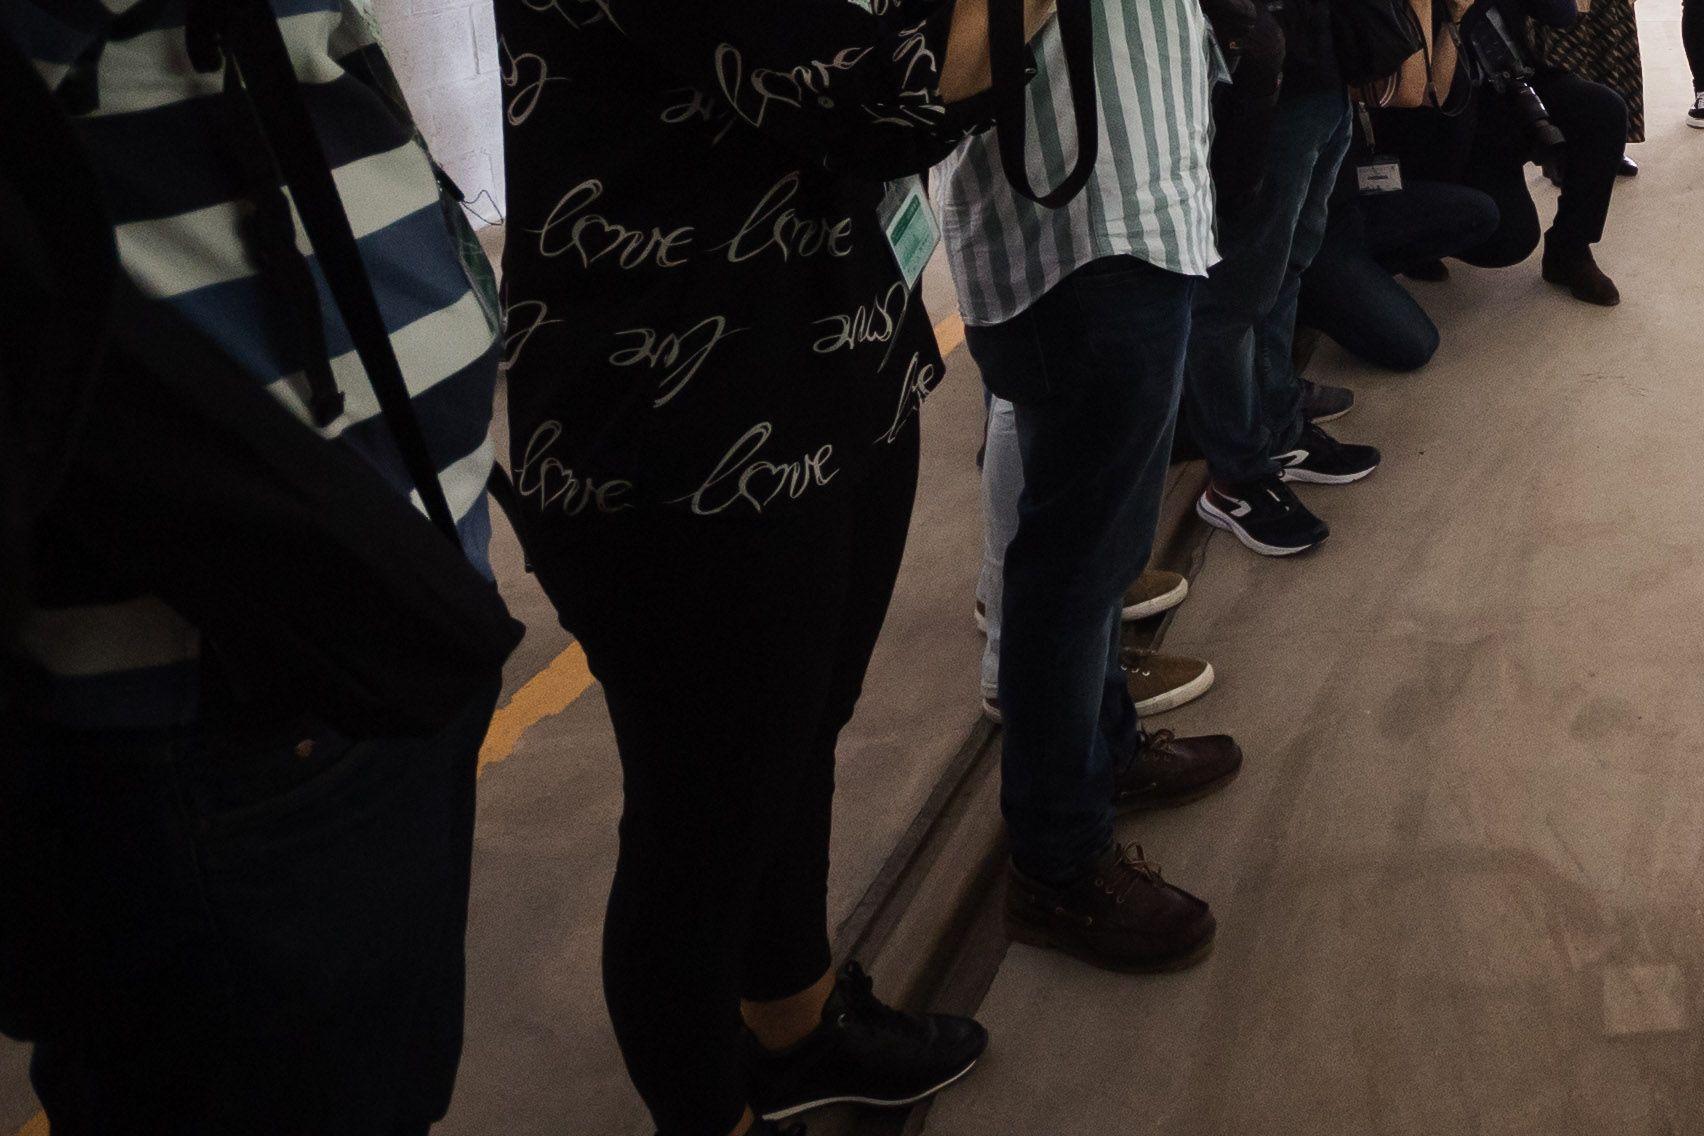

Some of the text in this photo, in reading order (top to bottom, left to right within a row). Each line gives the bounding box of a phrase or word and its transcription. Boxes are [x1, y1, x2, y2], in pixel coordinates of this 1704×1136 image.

[524, 178, 696, 269] love
[704, 171, 853, 263] love
[513, 419, 841, 516] love love
